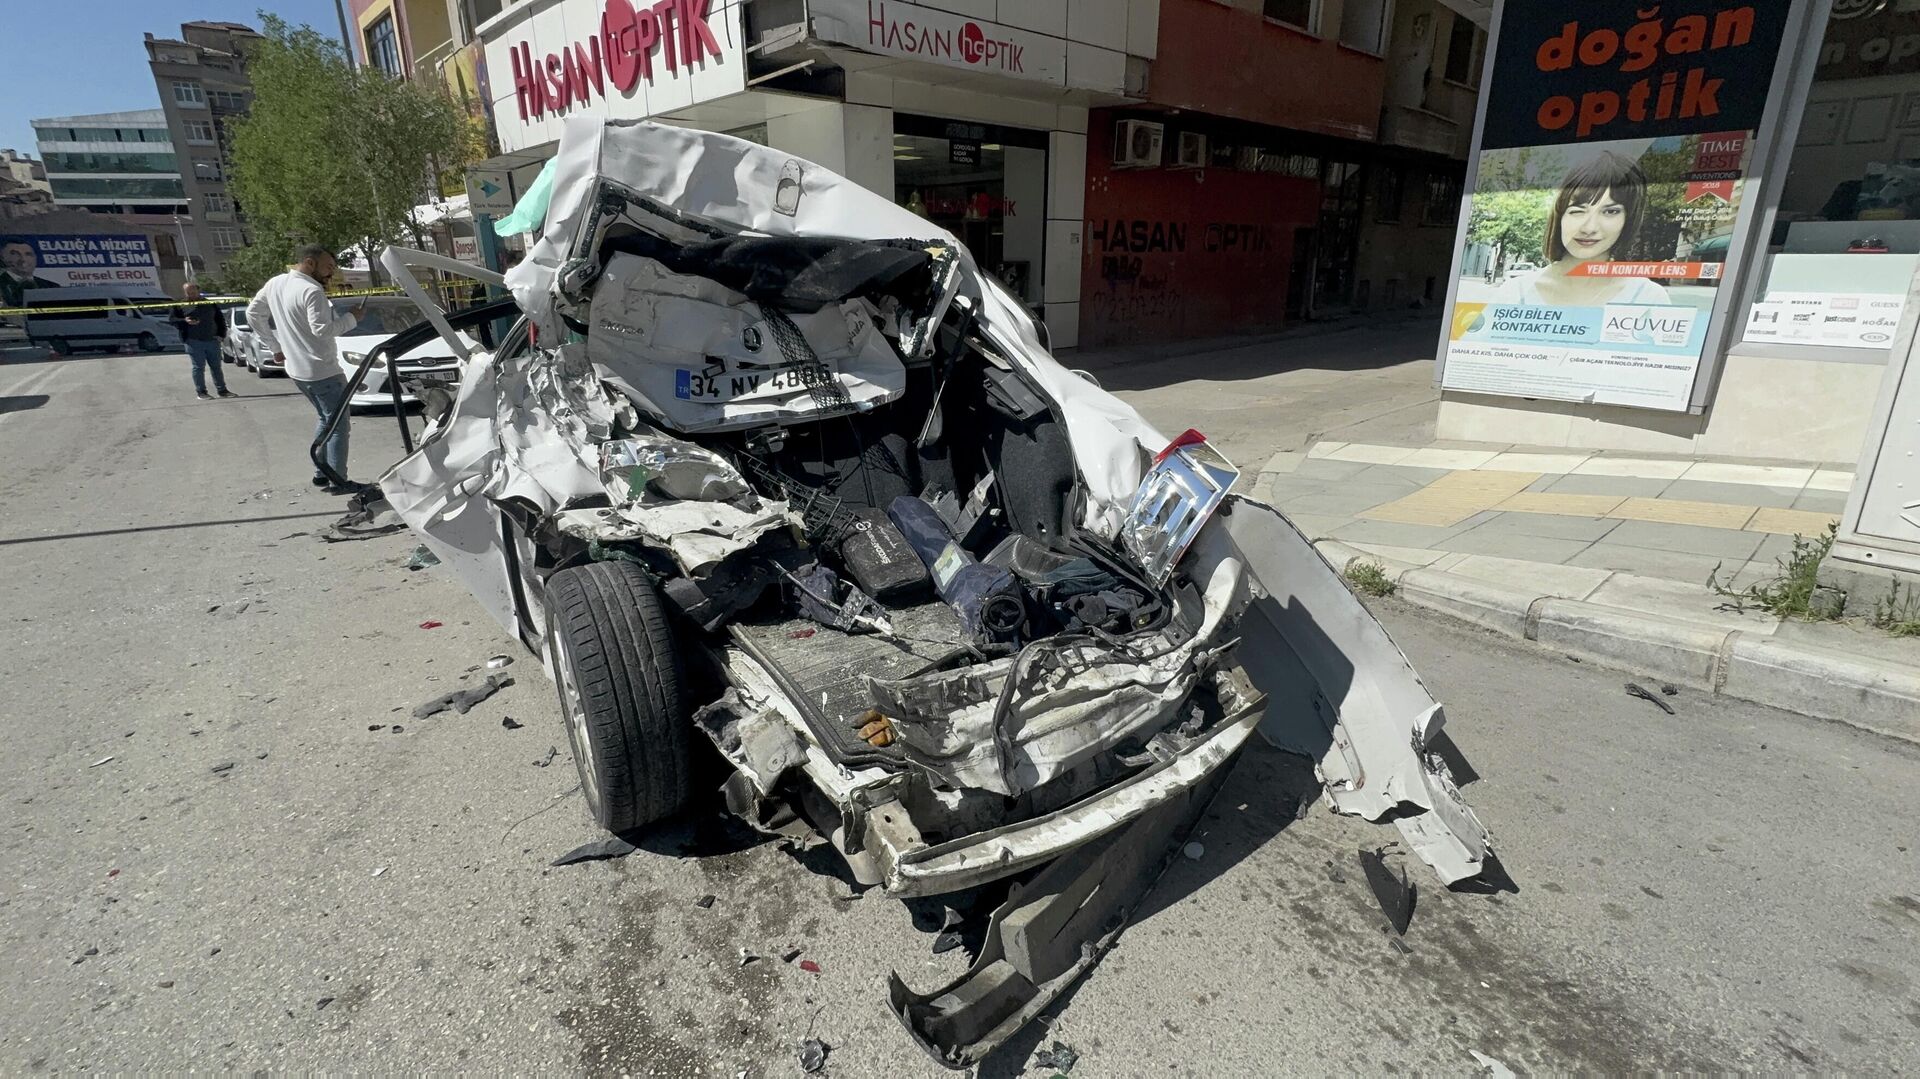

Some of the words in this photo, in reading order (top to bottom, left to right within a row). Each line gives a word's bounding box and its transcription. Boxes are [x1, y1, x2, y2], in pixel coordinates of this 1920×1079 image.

[868, 0, 950, 58] HASAN
[1536, 6, 1755, 72] doğan
[510, 35, 604, 121] HASAN
[1537, 68, 1725, 137] optik
[1701, 139, 1742, 153] TIME
[1698, 154, 1738, 169] BEST
[1691, 171, 1737, 180] INVENTIONS
[1087, 219, 1187, 253] HASAN
[38, 238, 98, 251] ELAZIĞ'A
[100, 238, 146, 251] HİZMET
[43, 251, 105, 265] BENİM
[109, 251, 151, 266] İŞİM
[67, 270, 112, 280] Gürsel
[116, 270, 151, 280] EROL
[1587, 263, 1608, 275] YENİ
[1611, 264, 1657, 275] KONTAKT
[1659, 265, 1688, 276] LENS
[1493, 307, 1523, 321] IŞIĞI
[1524, 308, 1562, 321] BİLEN
[1491, 321, 1551, 334] KONTAKT
[1552, 325, 1587, 336] LENS
[1606, 317, 1689, 333] ACUVUE
[1515, 352, 1530, 360] ÇOK
[679, 386, 689, 394] TR
[690, 375, 720, 398] 34
[731, 374, 760, 397] NV
